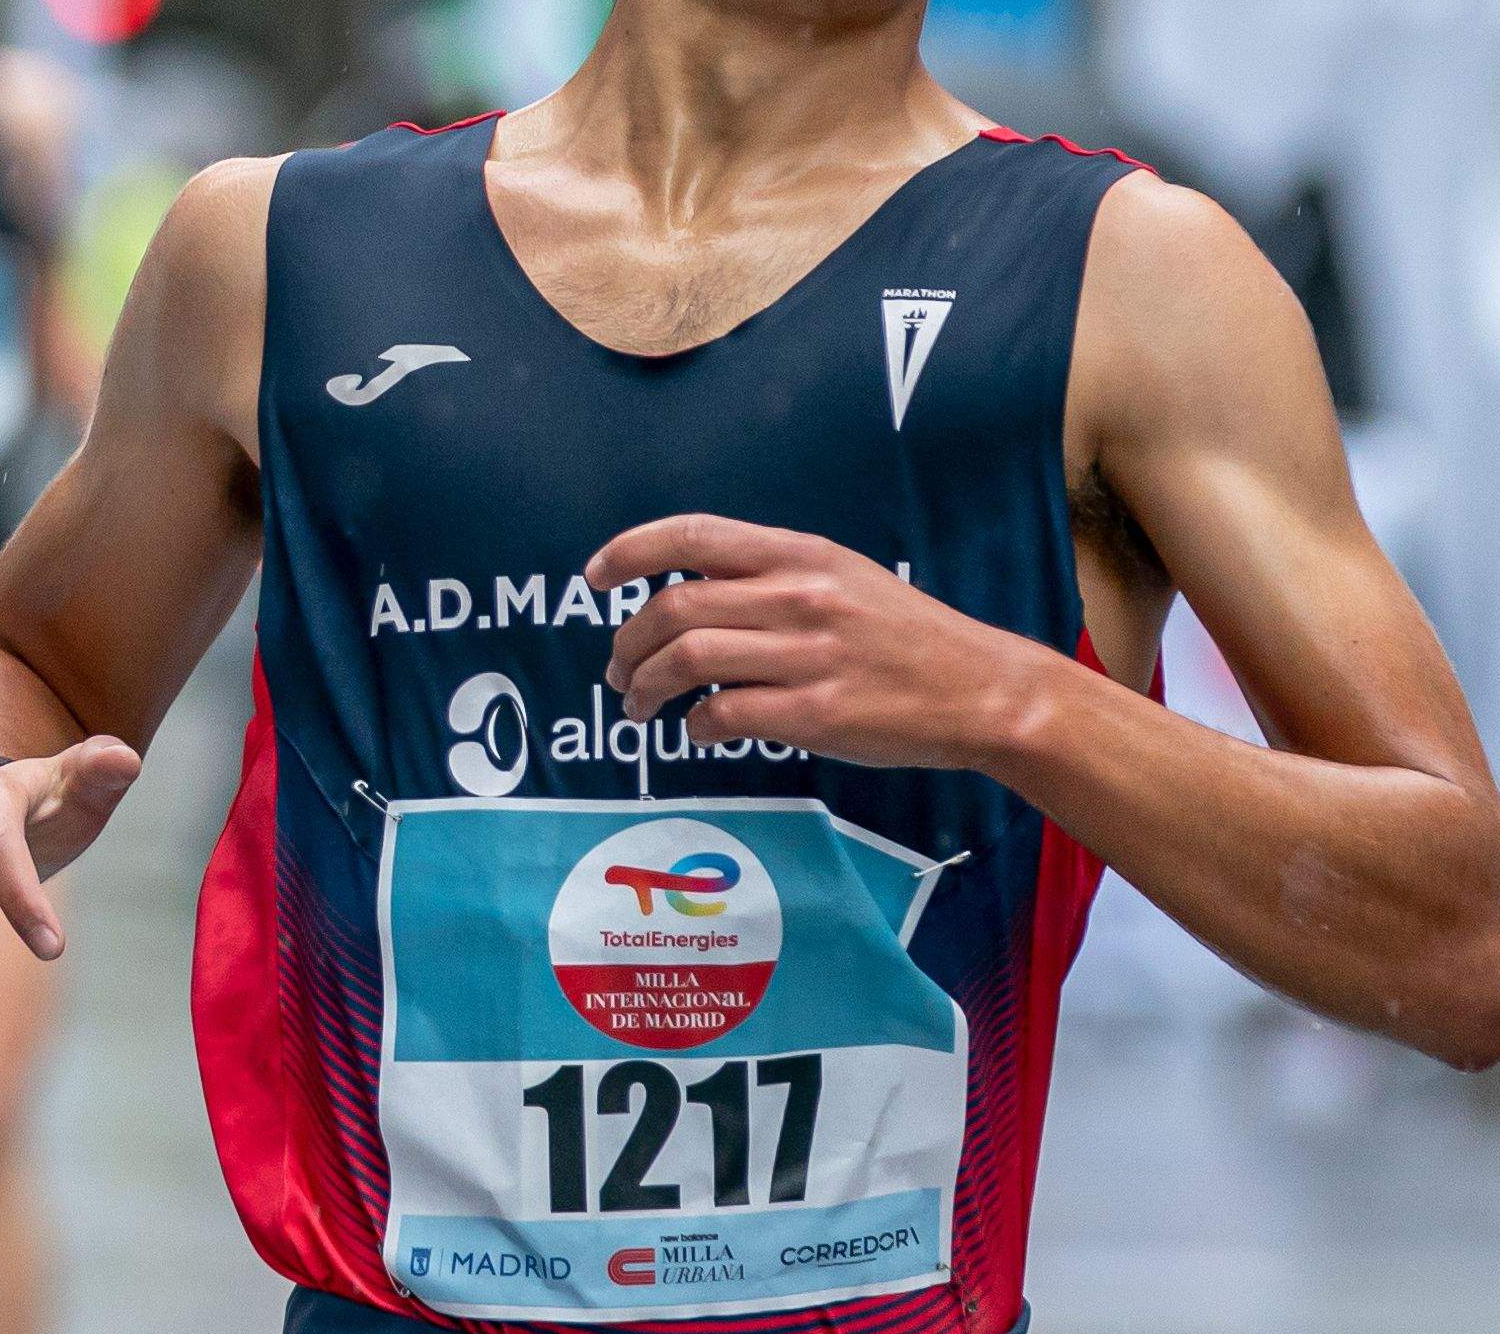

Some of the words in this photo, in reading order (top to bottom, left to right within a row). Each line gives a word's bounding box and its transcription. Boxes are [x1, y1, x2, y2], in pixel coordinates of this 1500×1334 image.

[883, 288, 957, 299] MARATHON
[600, 930, 739, 952] TotalEnergies
[635, 972, 699, 988] MILLA
[611, 1013, 639, 1029] DE
[645, 1011, 725, 1028] MADRID
[523, 1053, 822, 1213] 1217
[682, 1233, 718, 1241] balance
[662, 1244, 734, 1263] MILLA
[451, 1252, 571, 1280] MADRID
[662, 1264, 745, 1284] URBANA
